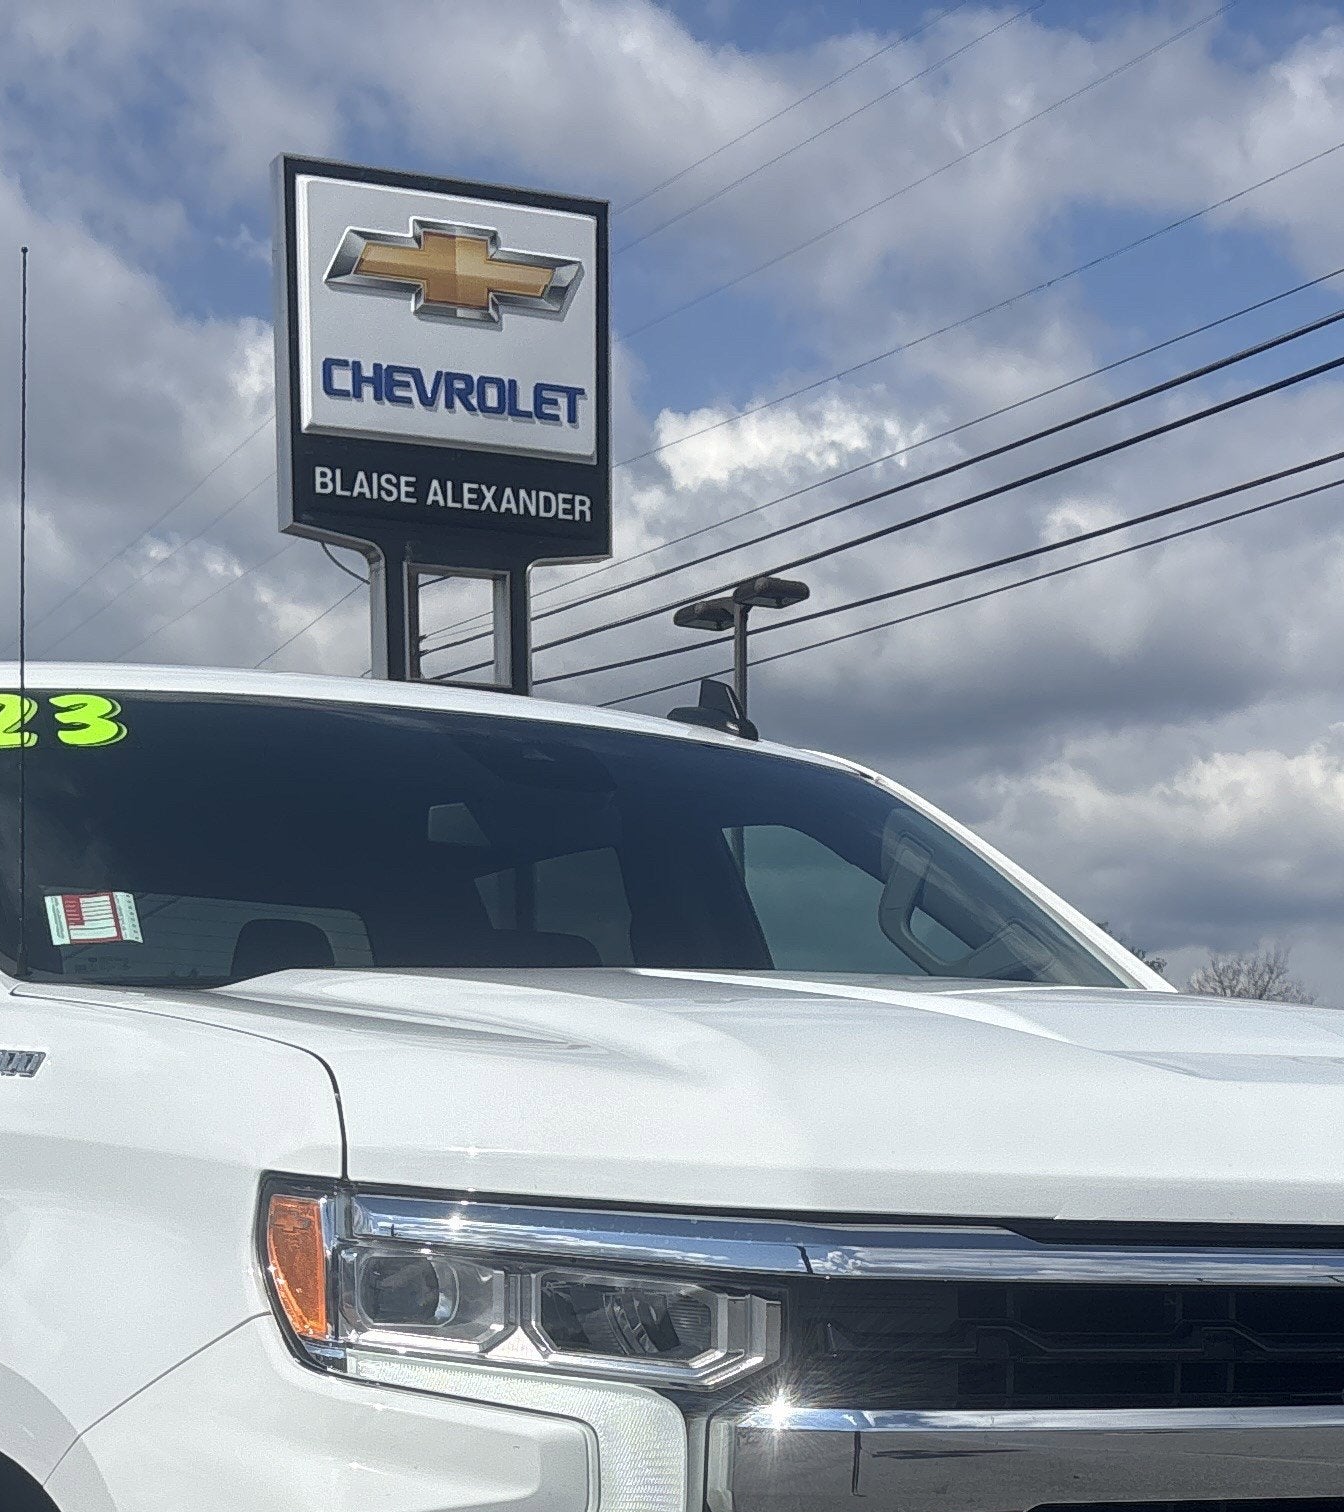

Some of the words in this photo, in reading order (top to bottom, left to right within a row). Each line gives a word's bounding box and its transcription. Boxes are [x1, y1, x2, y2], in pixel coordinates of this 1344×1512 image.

[322, 357, 586, 425] CHEVROLET
[314, 466, 418, 504] BLAISE
[426, 479, 592, 522] ALEXANDER
